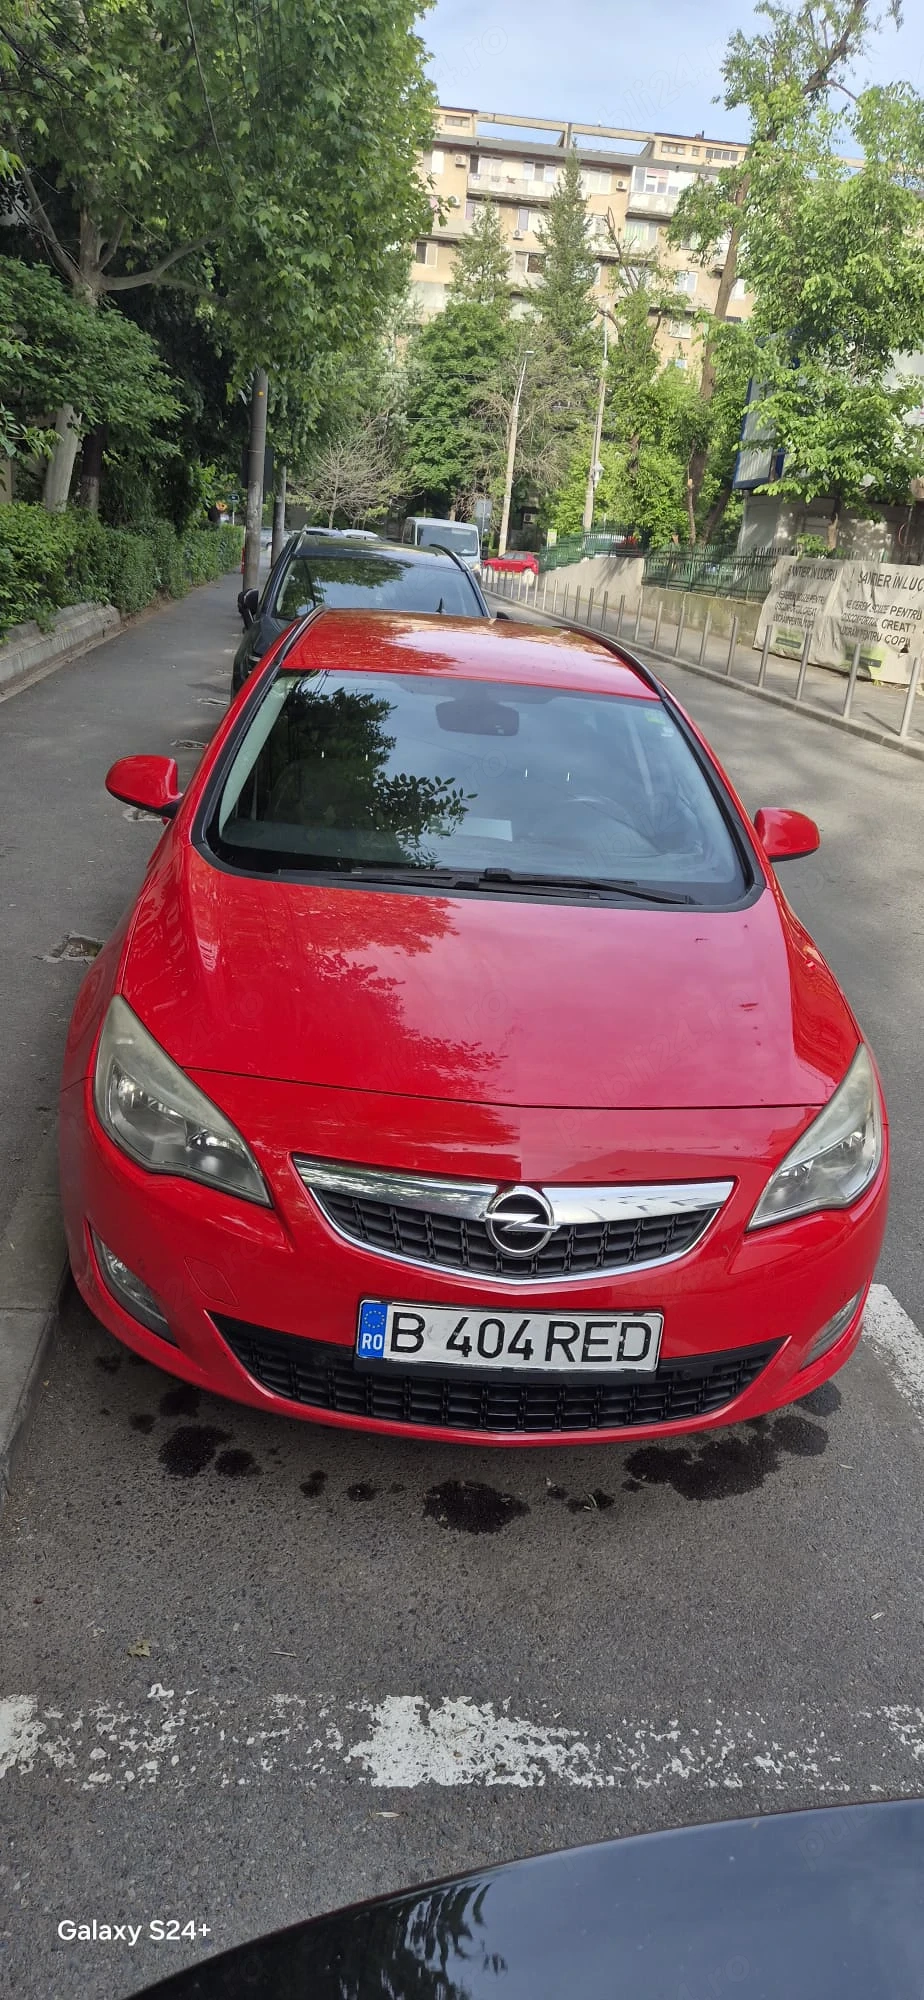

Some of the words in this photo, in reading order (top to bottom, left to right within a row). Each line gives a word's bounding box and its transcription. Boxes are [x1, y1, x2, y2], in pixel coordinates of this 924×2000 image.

[902, 575, 924, 592] LUC
[889, 605, 922, 621] PENTRU
[361, 1332, 383, 1351] RO
[389, 1311, 426, 1354] B
[445, 1316, 534, 1361] 404
[544, 1319, 651, 1363] RED
